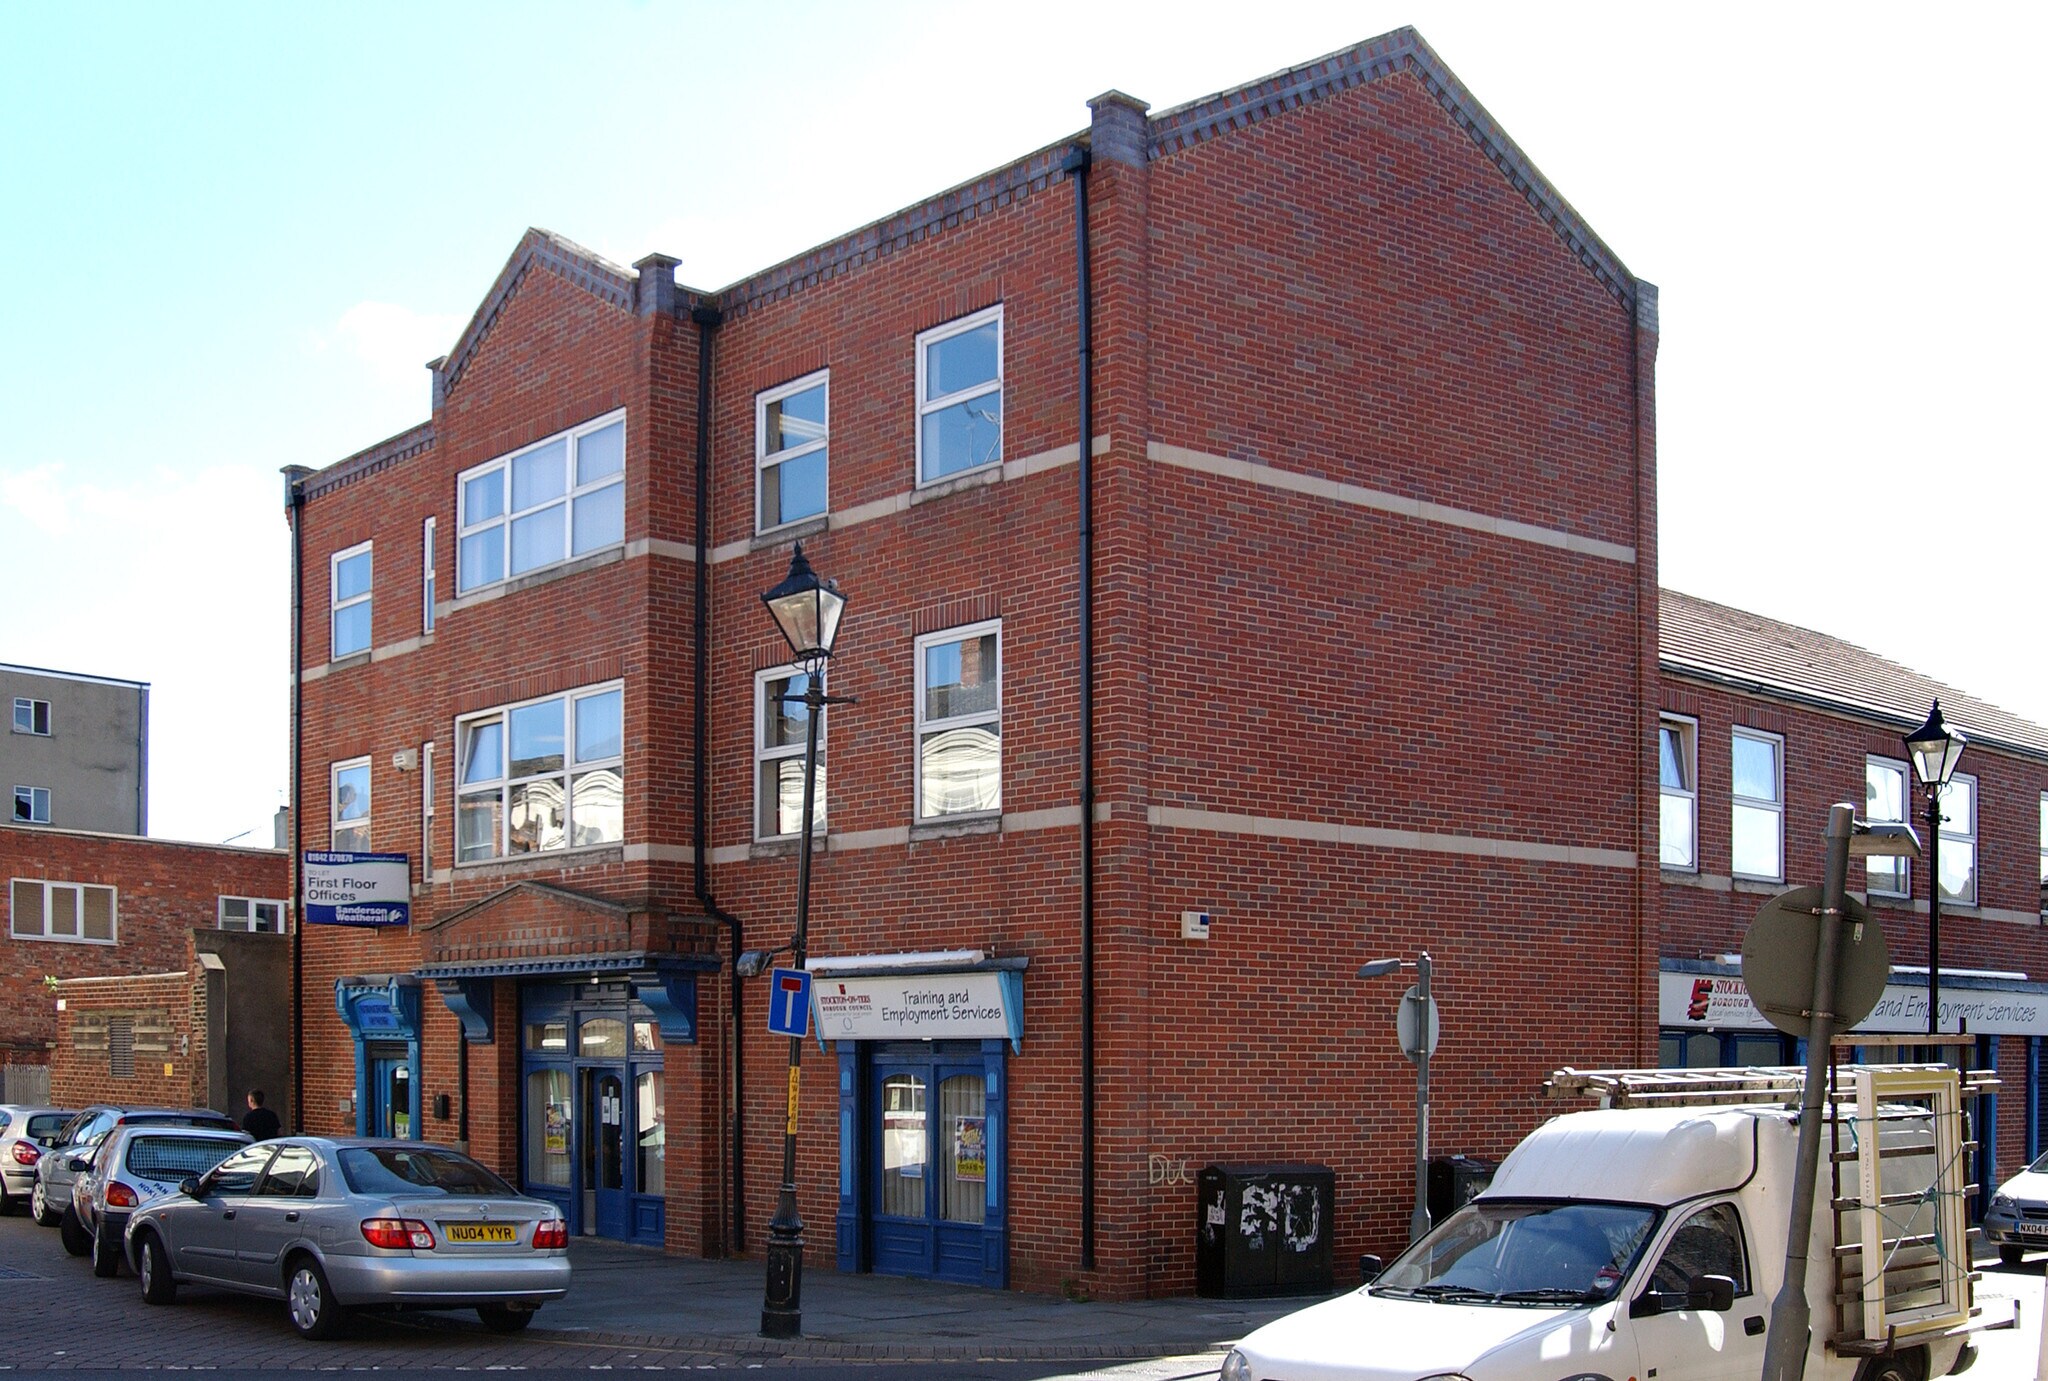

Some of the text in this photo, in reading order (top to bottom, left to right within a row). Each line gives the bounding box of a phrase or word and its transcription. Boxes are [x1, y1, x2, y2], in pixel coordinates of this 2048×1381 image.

[308, 877, 378, 889] First Floor
[308, 889, 356, 901] Offices
[335, 905, 388, 915] Sanderson
[335, 913, 388, 922] Weatherall
[1714, 979, 1749, 994] STOCKTO
[901, 988, 970, 1008] Training and
[1712, 997, 1749, 1008] BOROUGH
[882, 1004, 1001, 1026] Employment Services
[1875, 994, 2037, 1027] and Emoyment Services
[138, 1182, 157, 1198] NOKI
[153, 1182, 169, 1195] PAN
[452, 1227, 512, 1240] NU04 YYR
[2020, 1224, 2042, 1233] NX04
